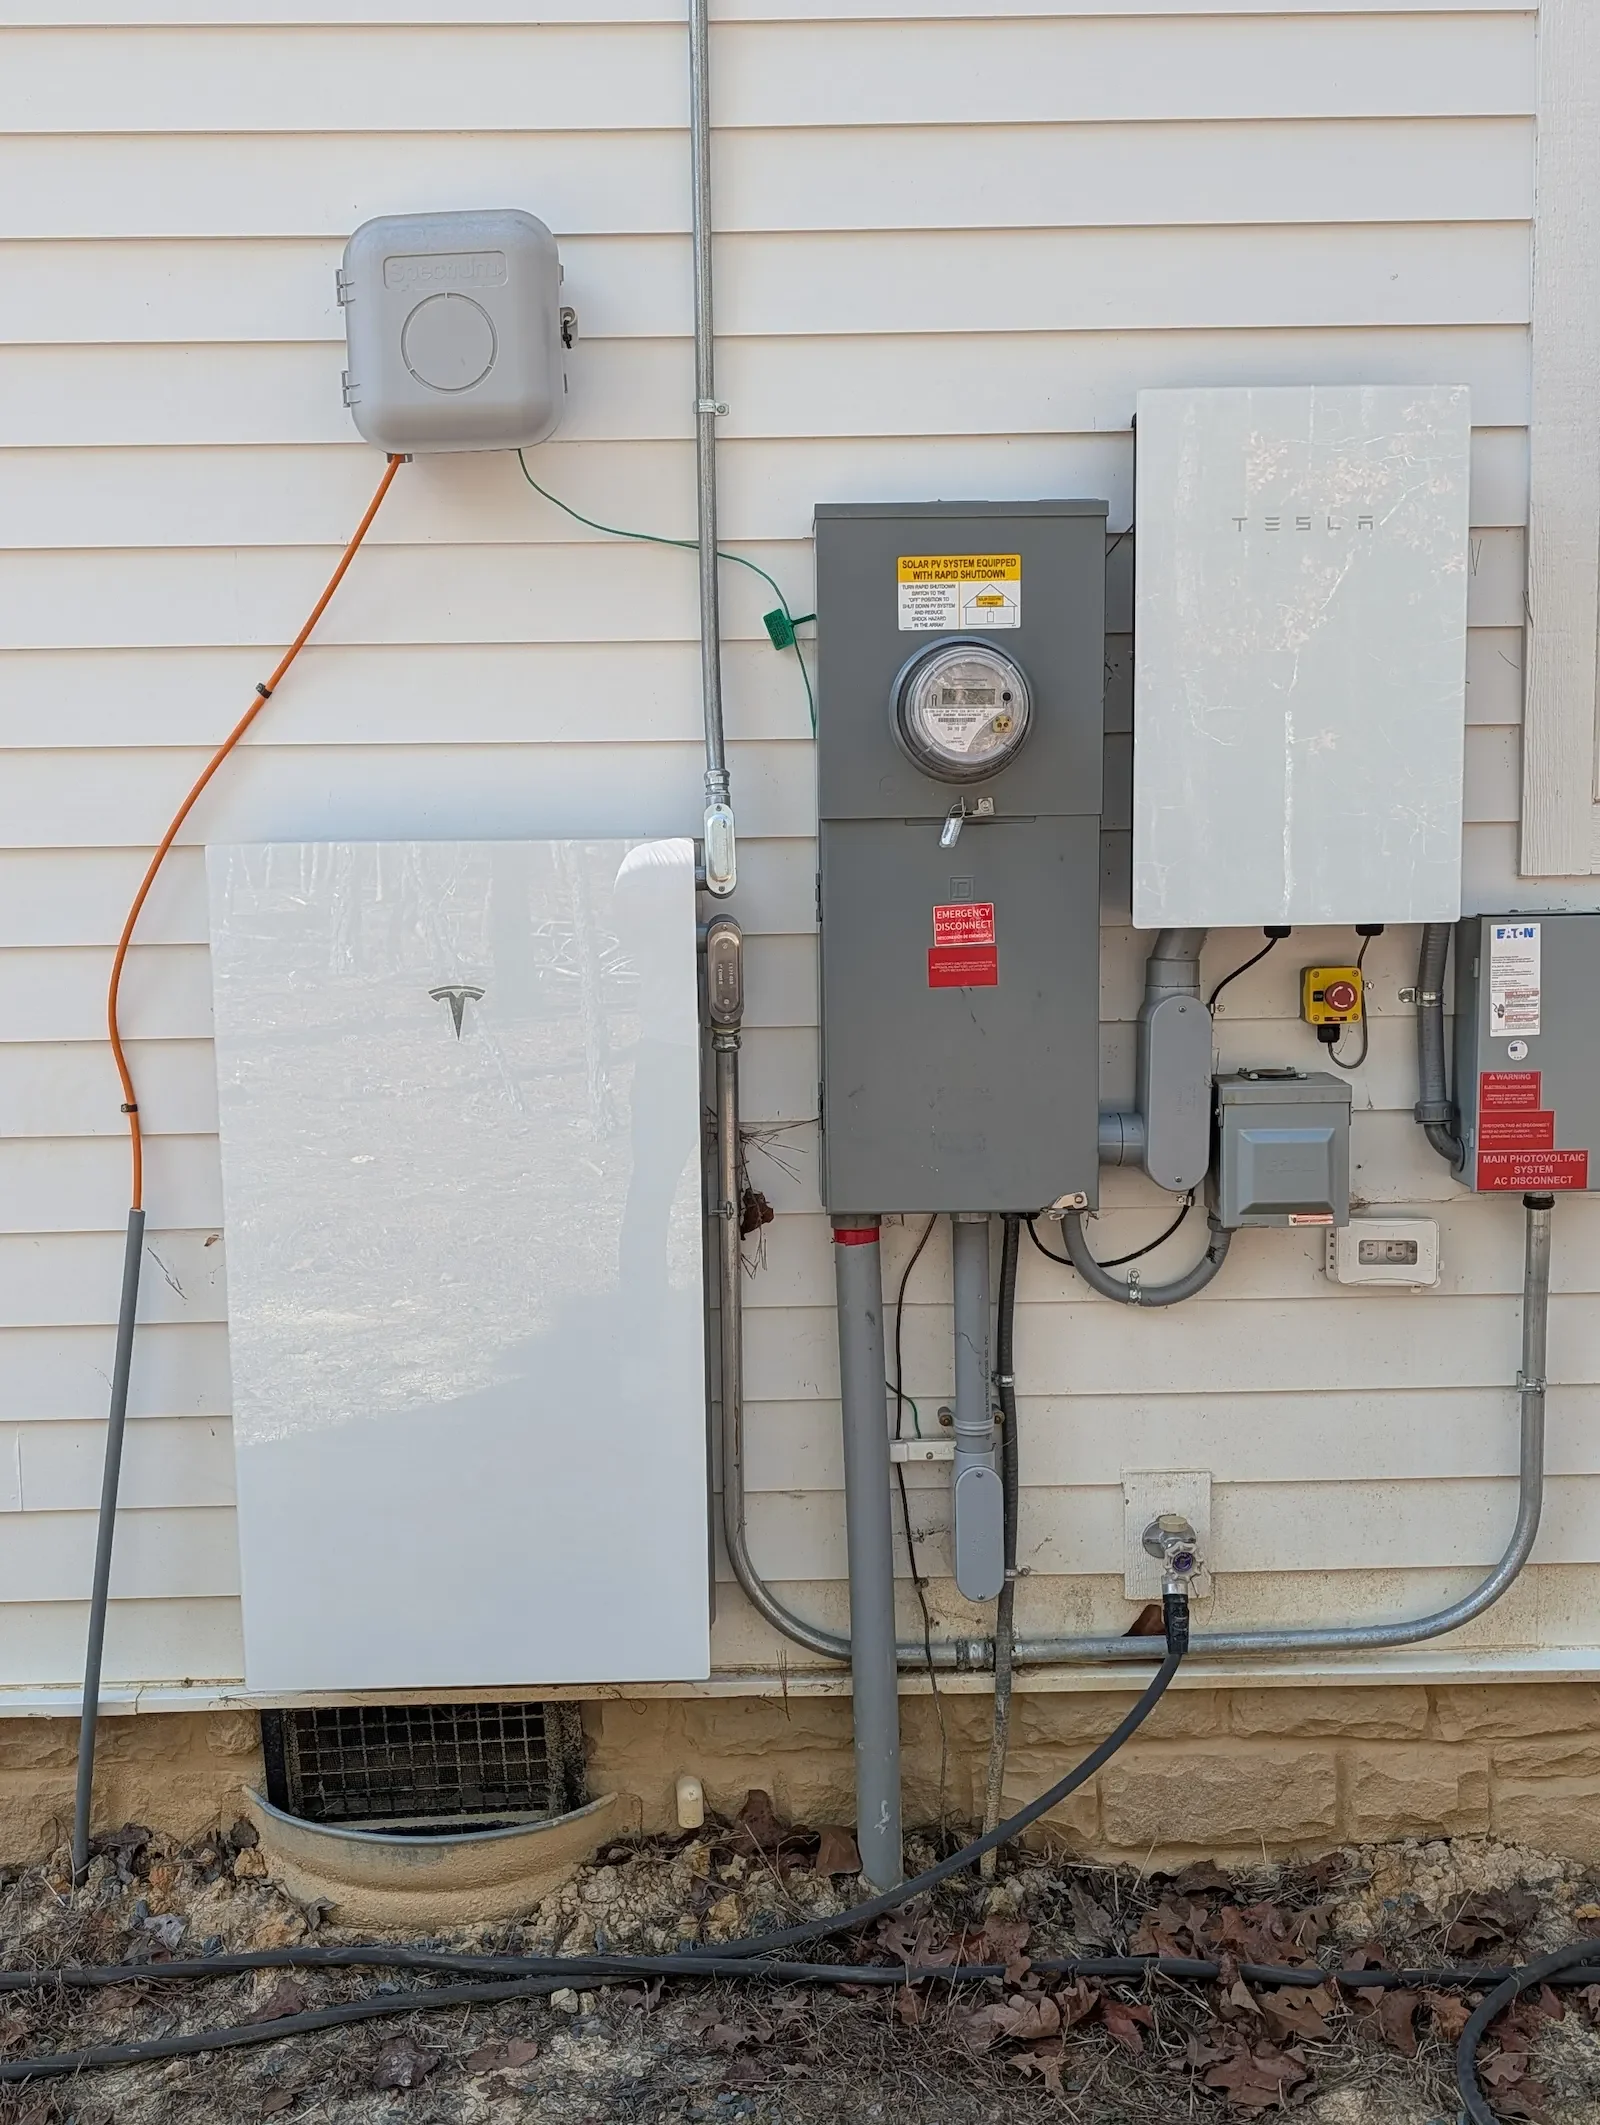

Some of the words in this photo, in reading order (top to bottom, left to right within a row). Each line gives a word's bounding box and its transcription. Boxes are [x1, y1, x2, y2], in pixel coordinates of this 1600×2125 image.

[1232, 515, 1373, 532] TESLA
[902, 560, 929, 568] SOLAR
[931, 560, 942, 568] PV
[944, 559, 974, 568] SYSTEM
[977, 558, 1016, 568] EQUIPPED
[912, 570, 932, 580] WITH
[934, 570, 958, 579] RAPID
[960, 569, 1006, 578] SHUTDOWN
[937, 908, 990, 919] EMERGENCY
[936, 920, 992, 931] DISCONNECT
[1496, 928, 1534, 939] EATON
[1483, 1155, 1508, 1163] MAIN
[1510, 1154, 1585, 1163] PHOTOVOLTAIC
[1514, 1165, 1553, 1174] SYSTEM
[1494, 1177, 1508, 1185] AC
[1510, 1176, 1573, 1185] DISCONNECT
